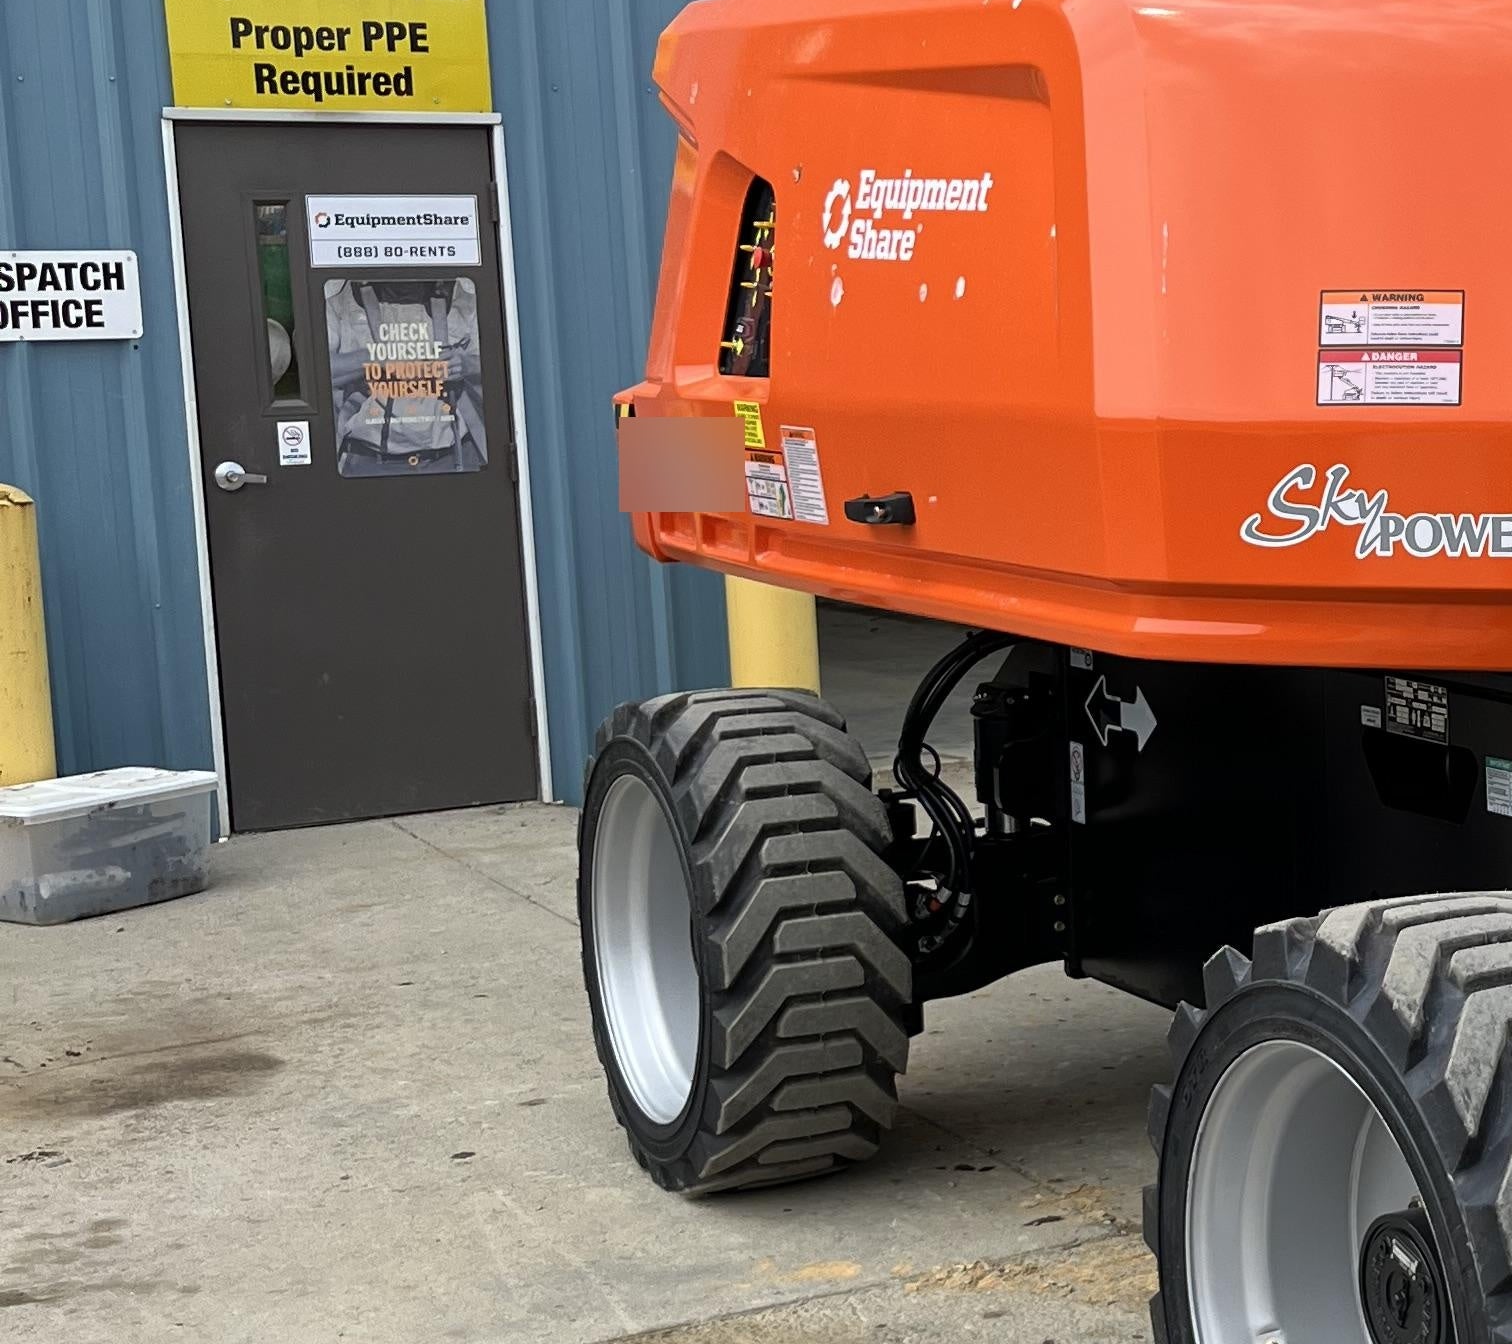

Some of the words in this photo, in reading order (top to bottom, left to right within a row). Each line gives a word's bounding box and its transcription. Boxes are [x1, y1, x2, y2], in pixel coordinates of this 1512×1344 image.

[230, 17, 351, 57] Proper
[362, 21, 429, 53] PPE
[254, 63, 414, 102] Required
[855, 168, 993, 220] Equipment
[334, 213, 470, 229] EquipmentShare
[848, 218, 917, 261] Share
[384, 246, 456, 257] 80-RENTS
[1372, 293, 1424, 302] WARNING
[379, 323, 429, 342] CHECK
[367, 341, 443, 361] YOURSELF
[1371, 352, 1418, 361] DANGER
[363, 362, 382, 380] TO
[385, 360, 449, 380] PROTECT
